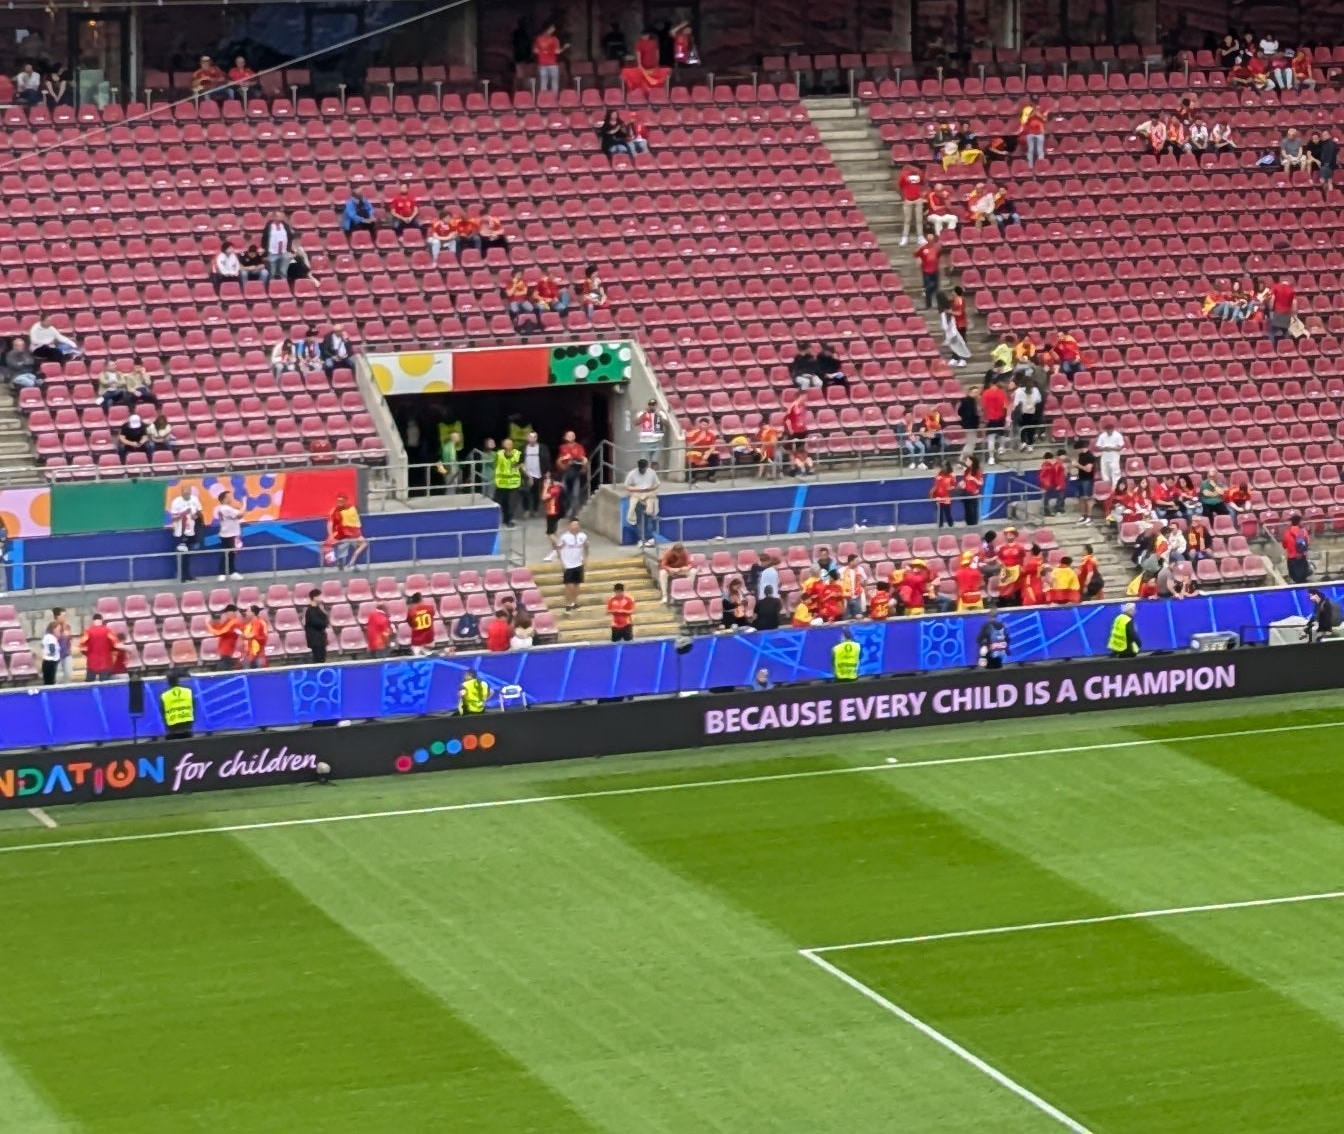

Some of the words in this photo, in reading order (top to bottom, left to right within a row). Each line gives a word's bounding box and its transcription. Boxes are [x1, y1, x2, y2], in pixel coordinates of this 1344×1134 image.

[415, 613, 432, 631] 10
[704, 699, 833, 735] BECAUSE
[840, 691, 928, 723] EVERY
[931, 684, 1018, 714] CHILD
[1024, 681, 1051, 706] IS
[1055, 678, 1079, 704] A
[1083, 664, 1237, 701] CHAMPION
[172, 752, 212, 792] for
[218, 746, 317, 779] children
